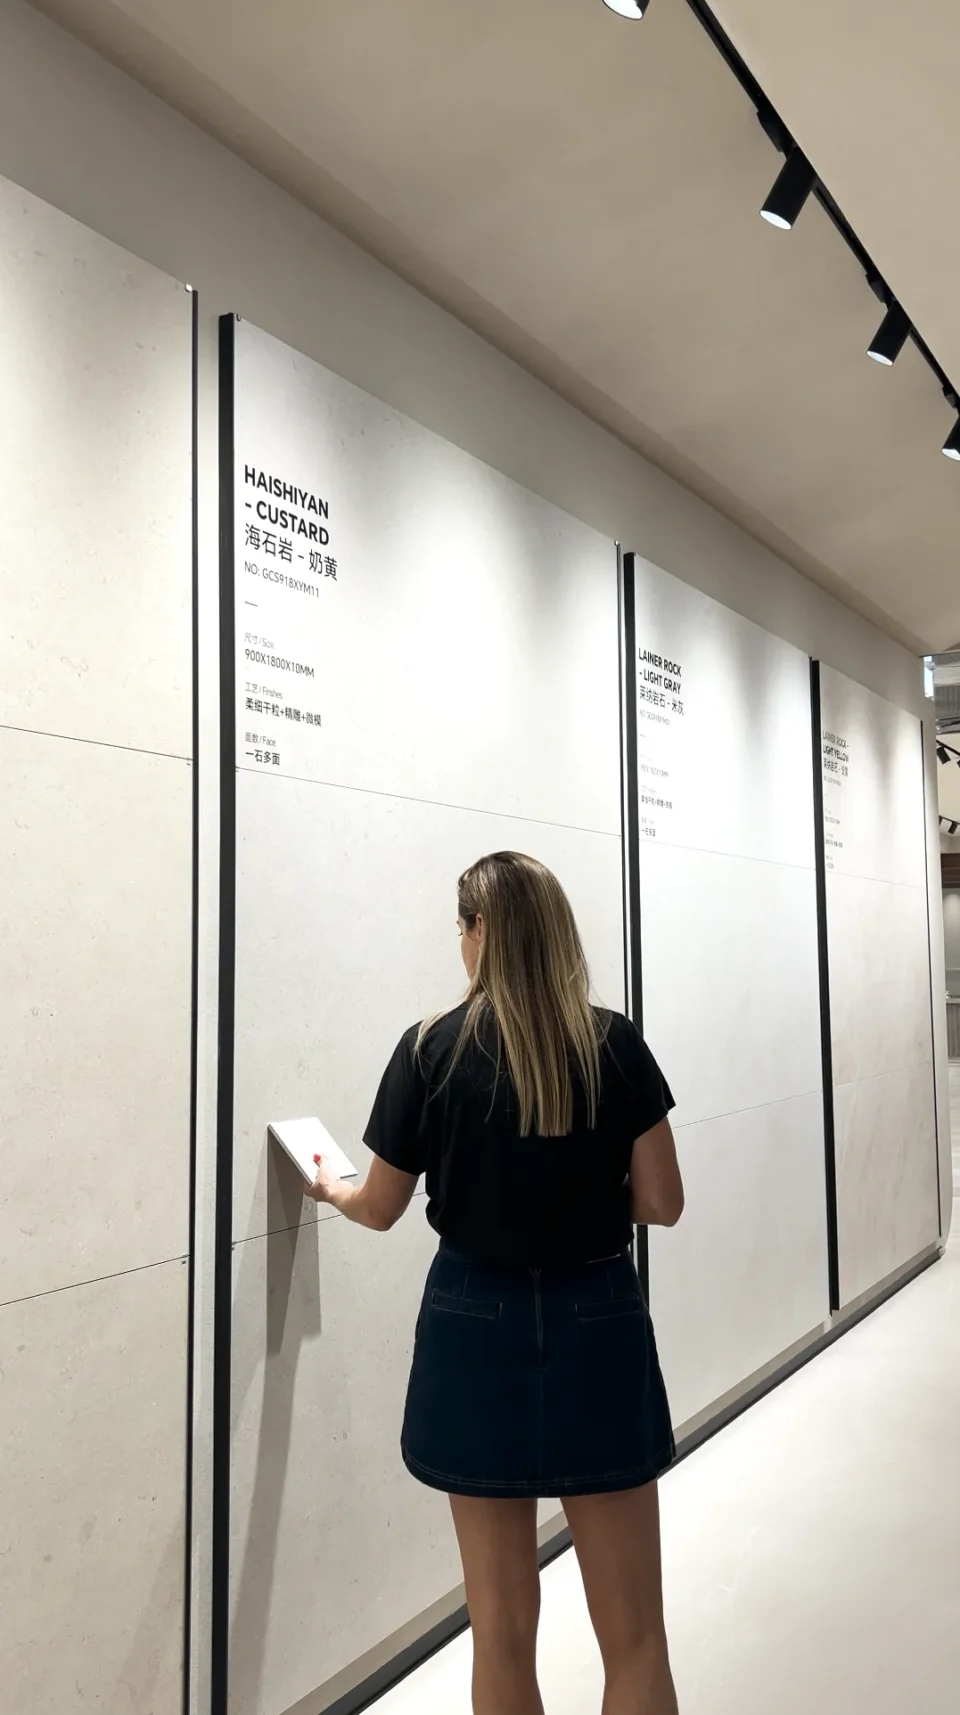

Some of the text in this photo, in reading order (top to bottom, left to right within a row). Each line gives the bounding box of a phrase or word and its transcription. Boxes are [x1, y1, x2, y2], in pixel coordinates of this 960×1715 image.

[245, 464, 329, 520] HAISHIYAN
[256, 500, 329, 546] CUSTARD
[245, 523, 293, 564] 海石岩
[309, 549, 338, 581] 奶黄
[245, 560, 319, 598] NO: GCS918XYM11
[245, 648, 315, 678] 900X1800X10MM
[639, 647, 682, 678] LAINER ROCK
[644, 668, 662, 687] LIGHT
[664, 677, 682, 695] GRAY
[245, 749, 281, 767] 一石多面
